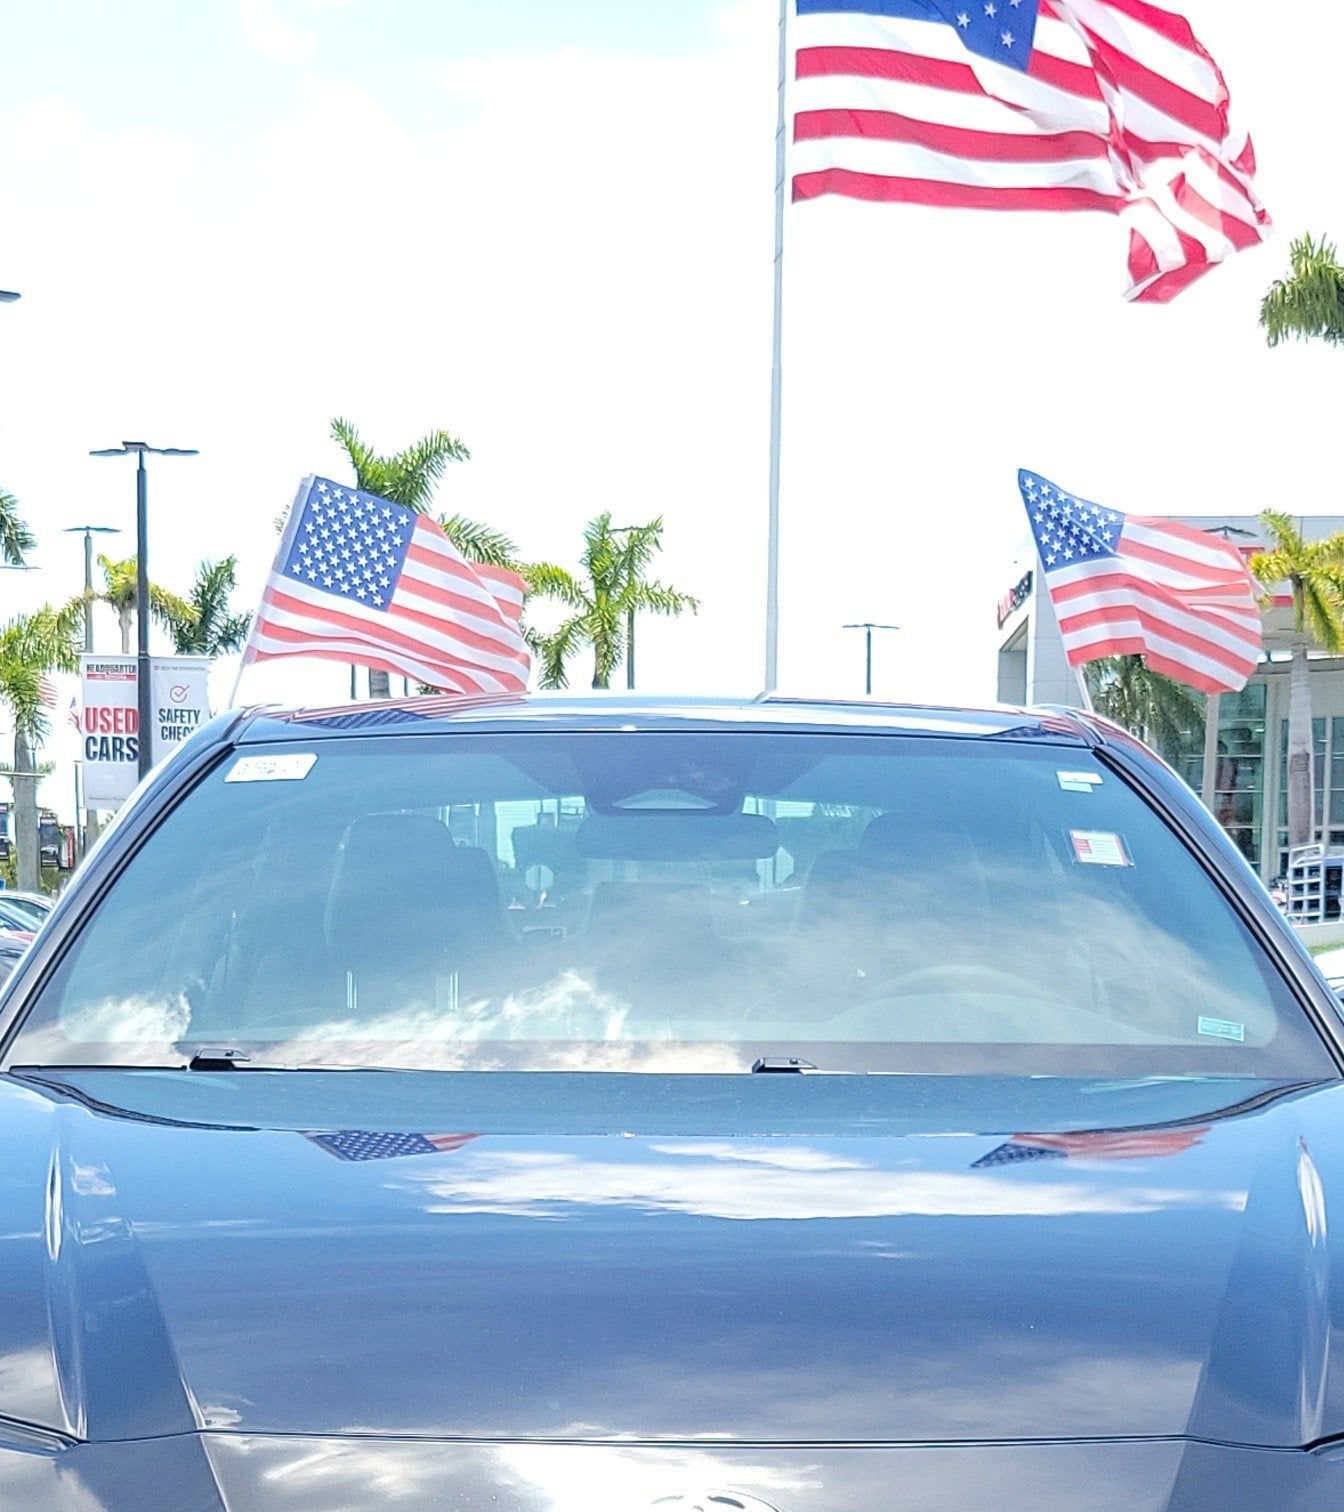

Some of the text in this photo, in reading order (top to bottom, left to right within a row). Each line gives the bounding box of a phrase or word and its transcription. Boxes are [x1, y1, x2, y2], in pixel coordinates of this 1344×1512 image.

[85, 707, 138, 735] USED
[158, 708, 201, 724] SAFETY
[161, 726, 195, 741] CHEC
[85, 736, 138, 762] CARS
